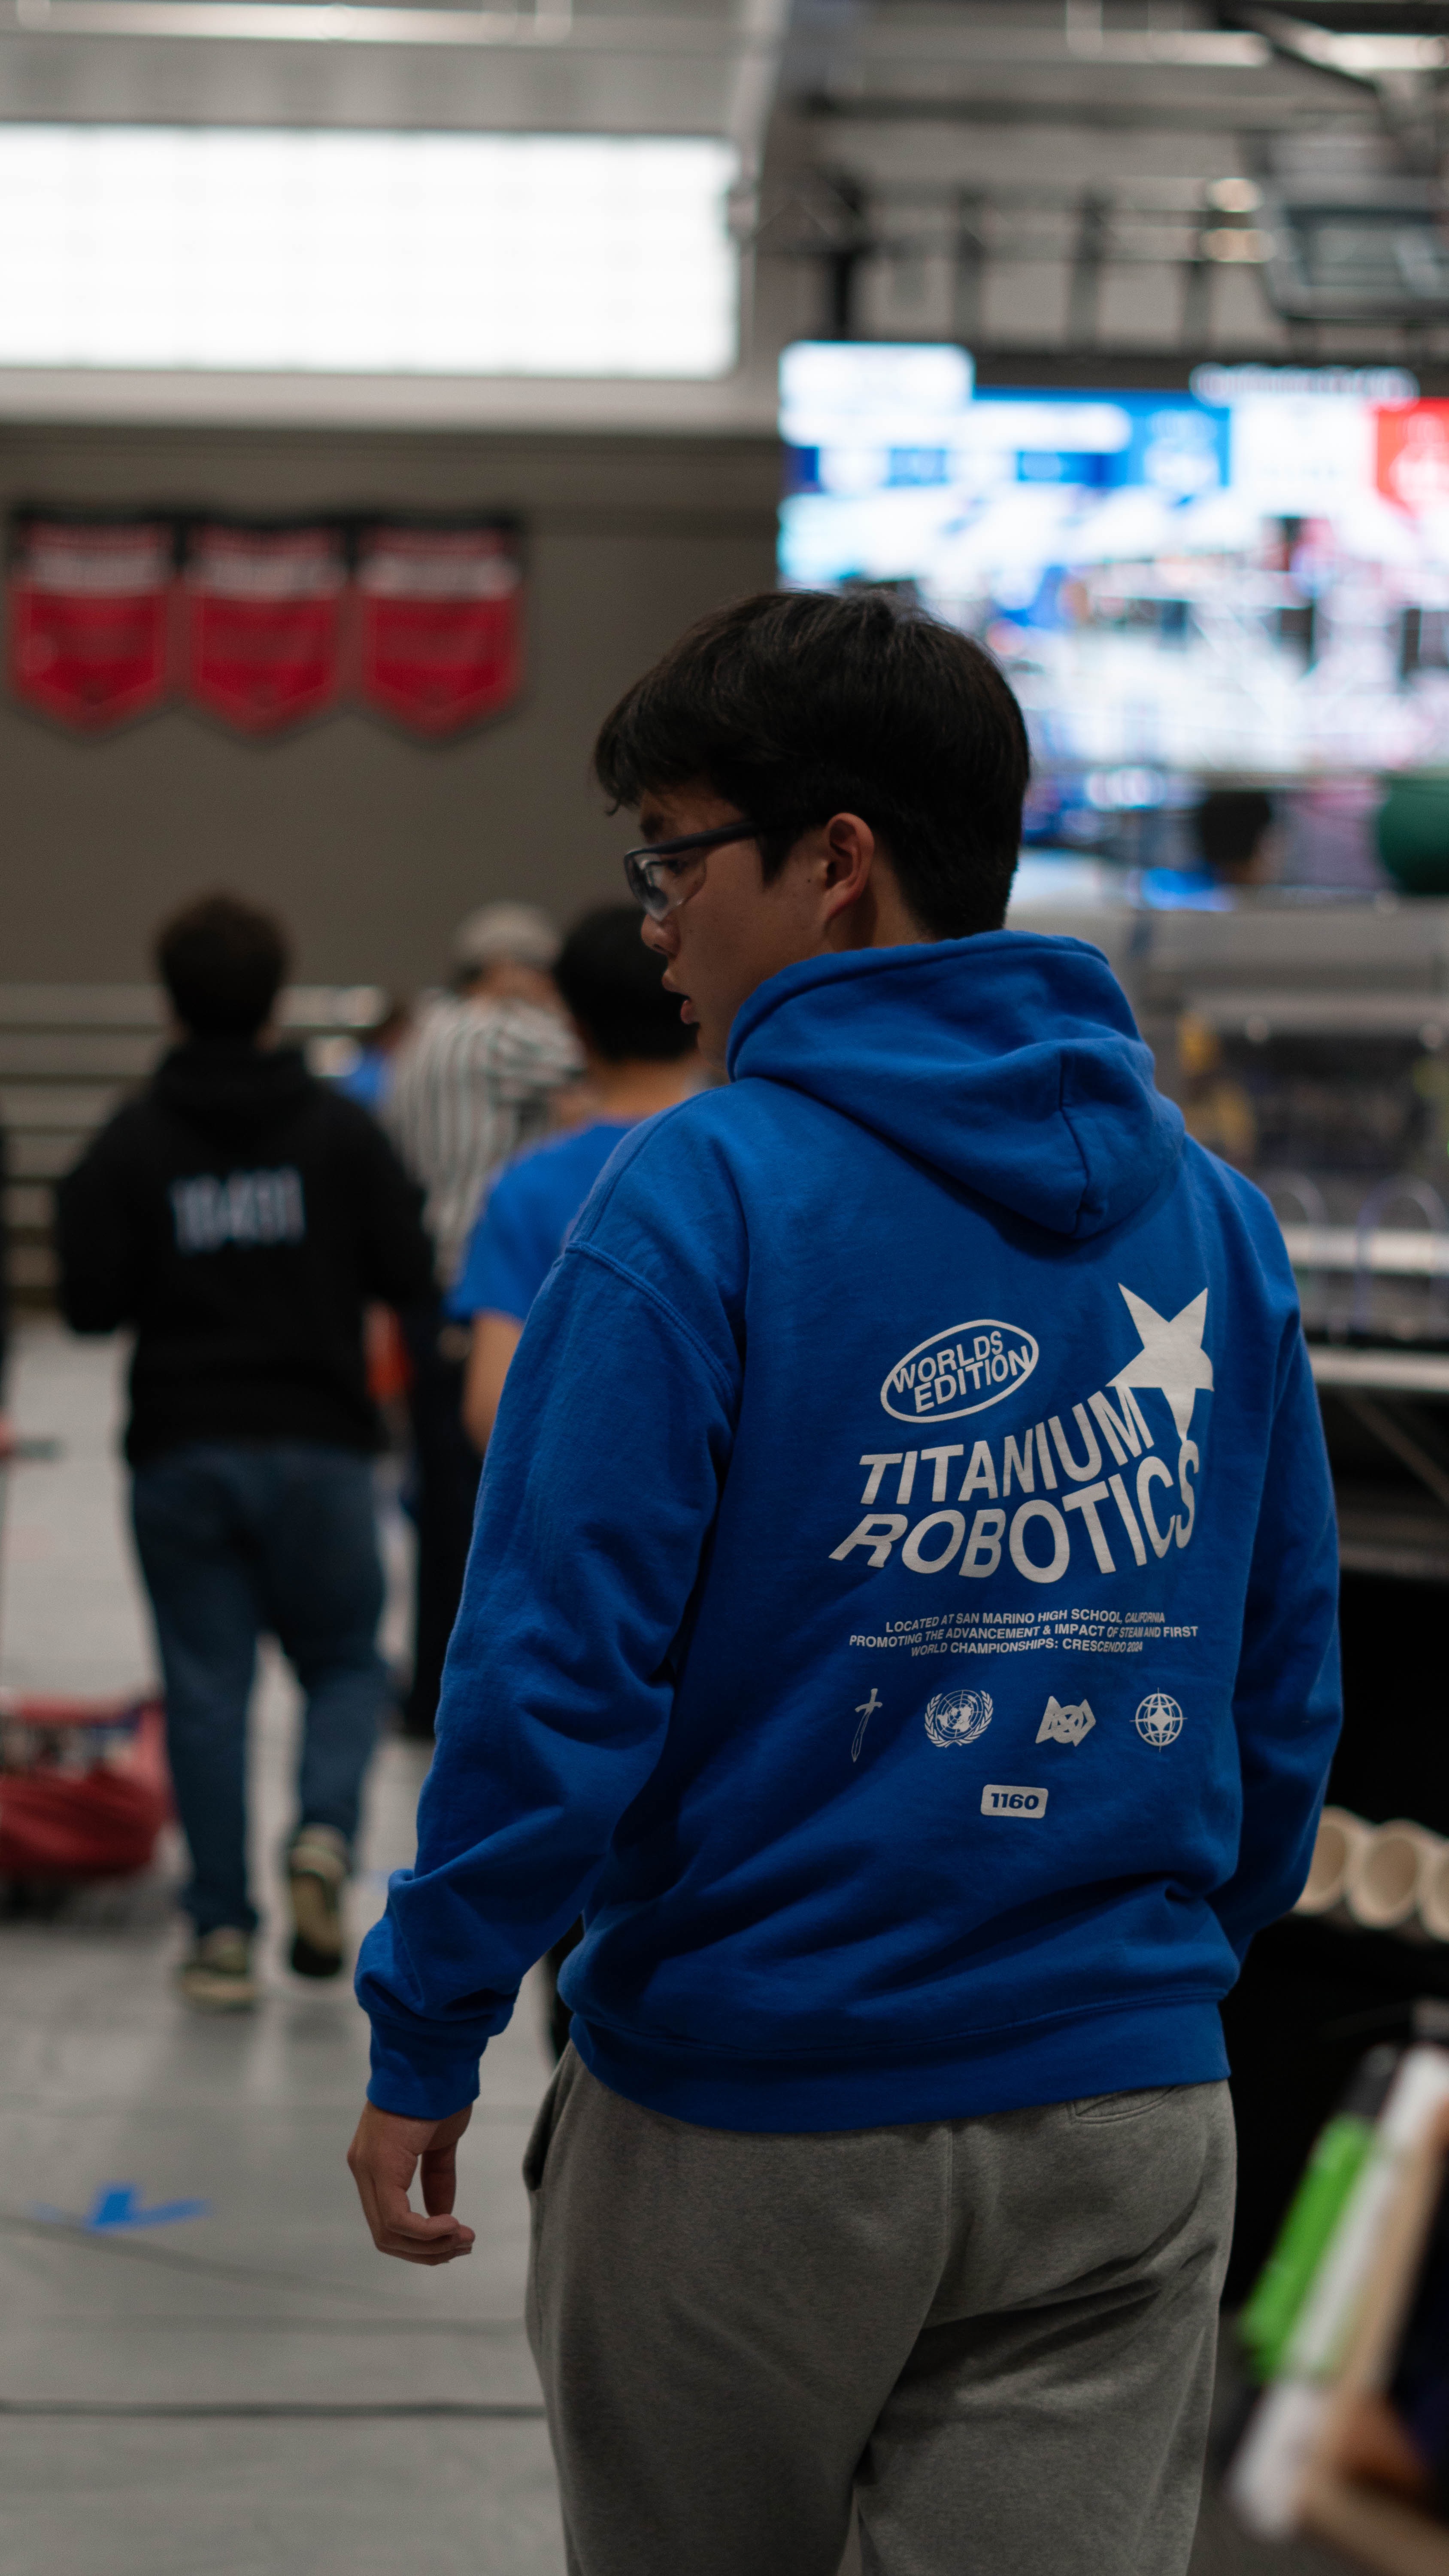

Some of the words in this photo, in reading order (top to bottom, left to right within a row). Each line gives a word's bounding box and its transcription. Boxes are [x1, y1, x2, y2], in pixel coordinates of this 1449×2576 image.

[892, 1331, 1003, 1393] WORLDS
[914, 1345, 1029, 1413] EDITION
[858, 1384, 1155, 1505] TITANIUM
[828, 1439, 1199, 1584] ROBOTICS
[849, 1632, 922, 1647] PROMOTING
[925, 1631, 945, 1641] THE
[945, 1626, 1040, 1639] ADVANCEMENT
[1043, 1625, 1051, 1635] &
[1055, 1623, 1105, 1637] IMPACT
[1107, 1626, 1119, 1638] OF
[1119, 1627, 1143, 1638] STEAM
[1143, 1627, 1161, 1637] AND
[1163, 1626, 1198, 1637] FIRST
[886, 1616, 939, 1633] LOCATED
[941, 1613, 955, 1625] AT
[956, 1613, 979, 1624] SAN
[982, 1613, 1035, 1624] MARINO
[1037, 1610, 1068, 1622] HIGH
[1071, 1608, 1123, 1625] SCHOOL,
[1125, 1612, 1166, 1623] CALIFORNIA
[911, 1643, 947, 1656] WORLD
[950, 1637, 1058, 1654] CHAMPIONSHIPS:
[1062, 1638, 1127, 1653] CRESCENDO
[1127, 1641, 1143, 1653] 2024
[991, 1793, 1040, 1810] 1160
